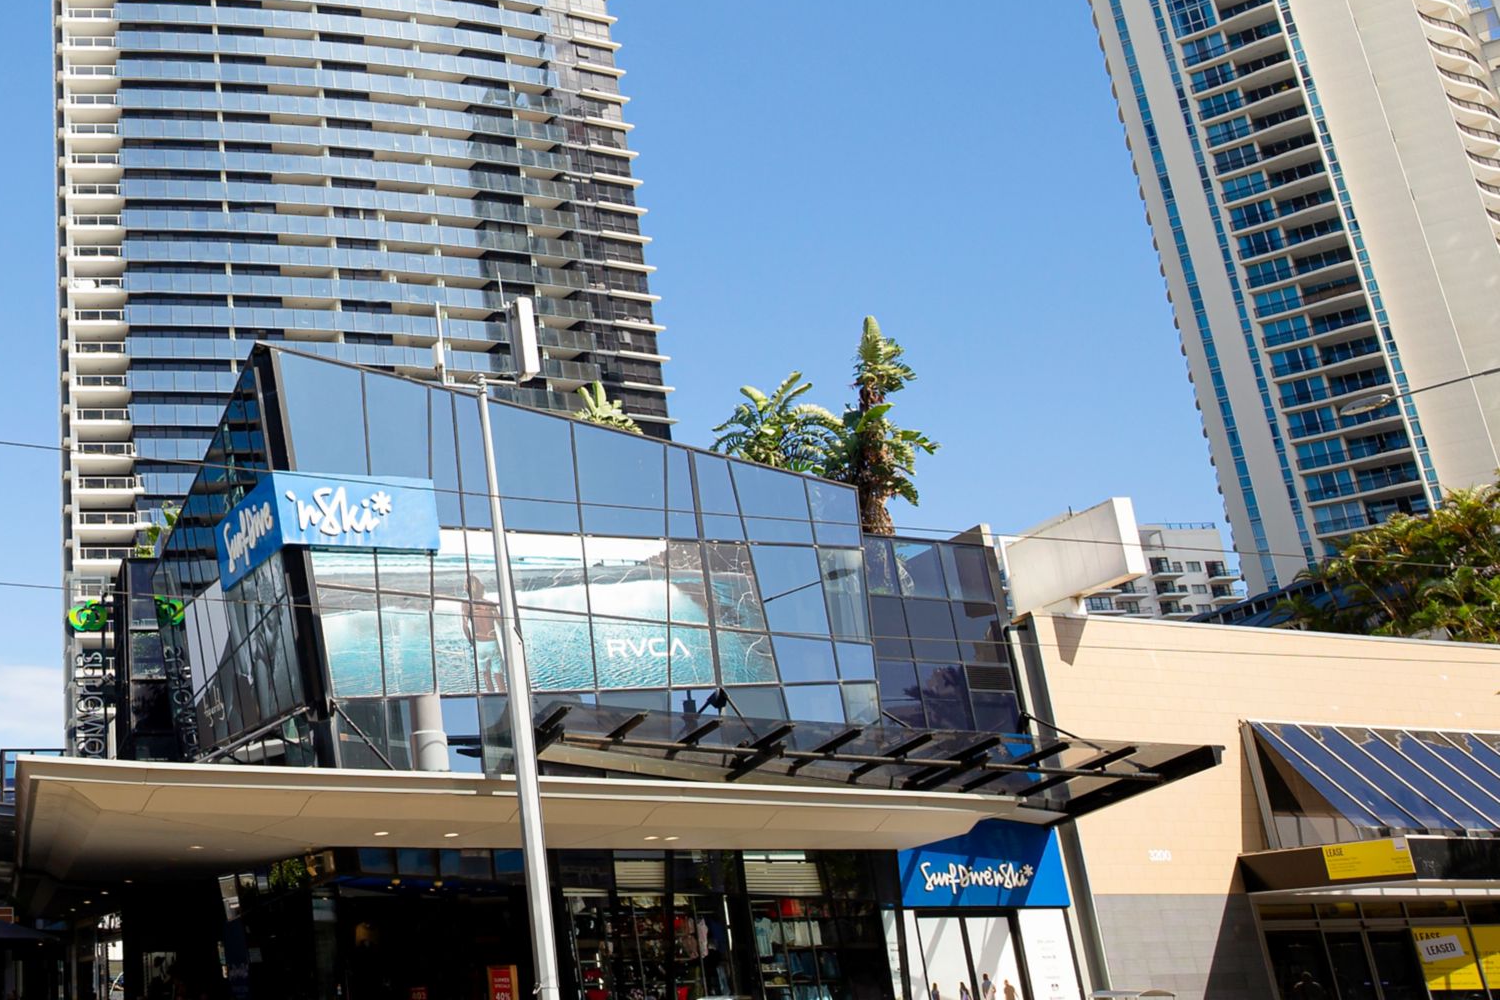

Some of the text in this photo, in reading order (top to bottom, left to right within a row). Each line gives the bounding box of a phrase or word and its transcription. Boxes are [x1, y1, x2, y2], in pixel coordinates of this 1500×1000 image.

[606, 638, 691, 658] RVCA
[1325, 848, 1344, 858] LEASE
[1426, 943, 1457, 956] LEASED
